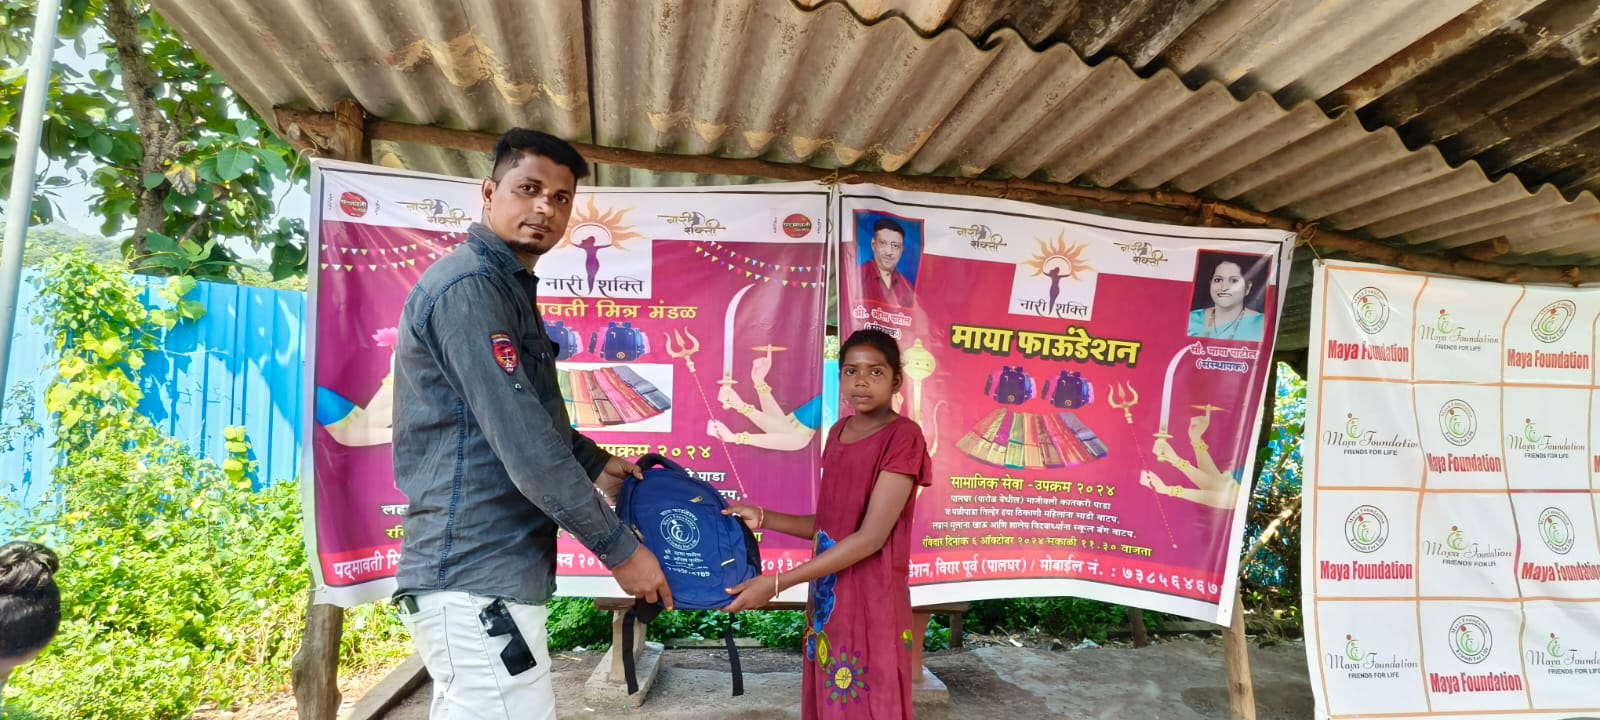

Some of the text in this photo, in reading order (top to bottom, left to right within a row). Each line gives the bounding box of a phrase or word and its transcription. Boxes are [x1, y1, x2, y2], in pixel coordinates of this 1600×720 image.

[541, 275, 645, 298] नारी शक्ति
[596, 300, 641, 319] मित्र
[648, 300, 698, 319] मंडळ
[1017, 297, 1088, 319] नारी शक्ति
[951, 325, 1141, 366] माया फाऊंडेशन
[1207, 346, 1229, 358] माया
[1230, 346, 1259, 359] पाटील
[1328, 340, 1409, 363] Maya Foundation
[1507, 349, 1588, 369] Maya Foundation
[658, 446, 711, 460] २०२४
[1448, 453, 1502, 473] Foundation
[698, 471, 726, 482] पाडा
[950, 472, 999, 490] सामाजिक
[1002, 474, 1024, 491] सेवा
[1077, 482, 1115, 498] २०२४
[1046, 535, 1077, 547] सकाळी
[1120, 544, 1153, 557] वाजता
[333, 550, 384, 580] पद्मावती
[935, 557, 960, 576] विरार
[962, 554, 979, 578] पूर्व
[981, 558, 1027, 575] (पालघर)
[1040, 554, 1083, 572] मोबाईल
[1122, 566, 1220, 595] ७३८५६४६७
[1320, 561, 1412, 581] Maya Foundation
[1521, 562, 1555, 583] Maya
[1362, 653, 1418, 669] Foundation
[1429, 672, 1523, 694] Maya Foundation
